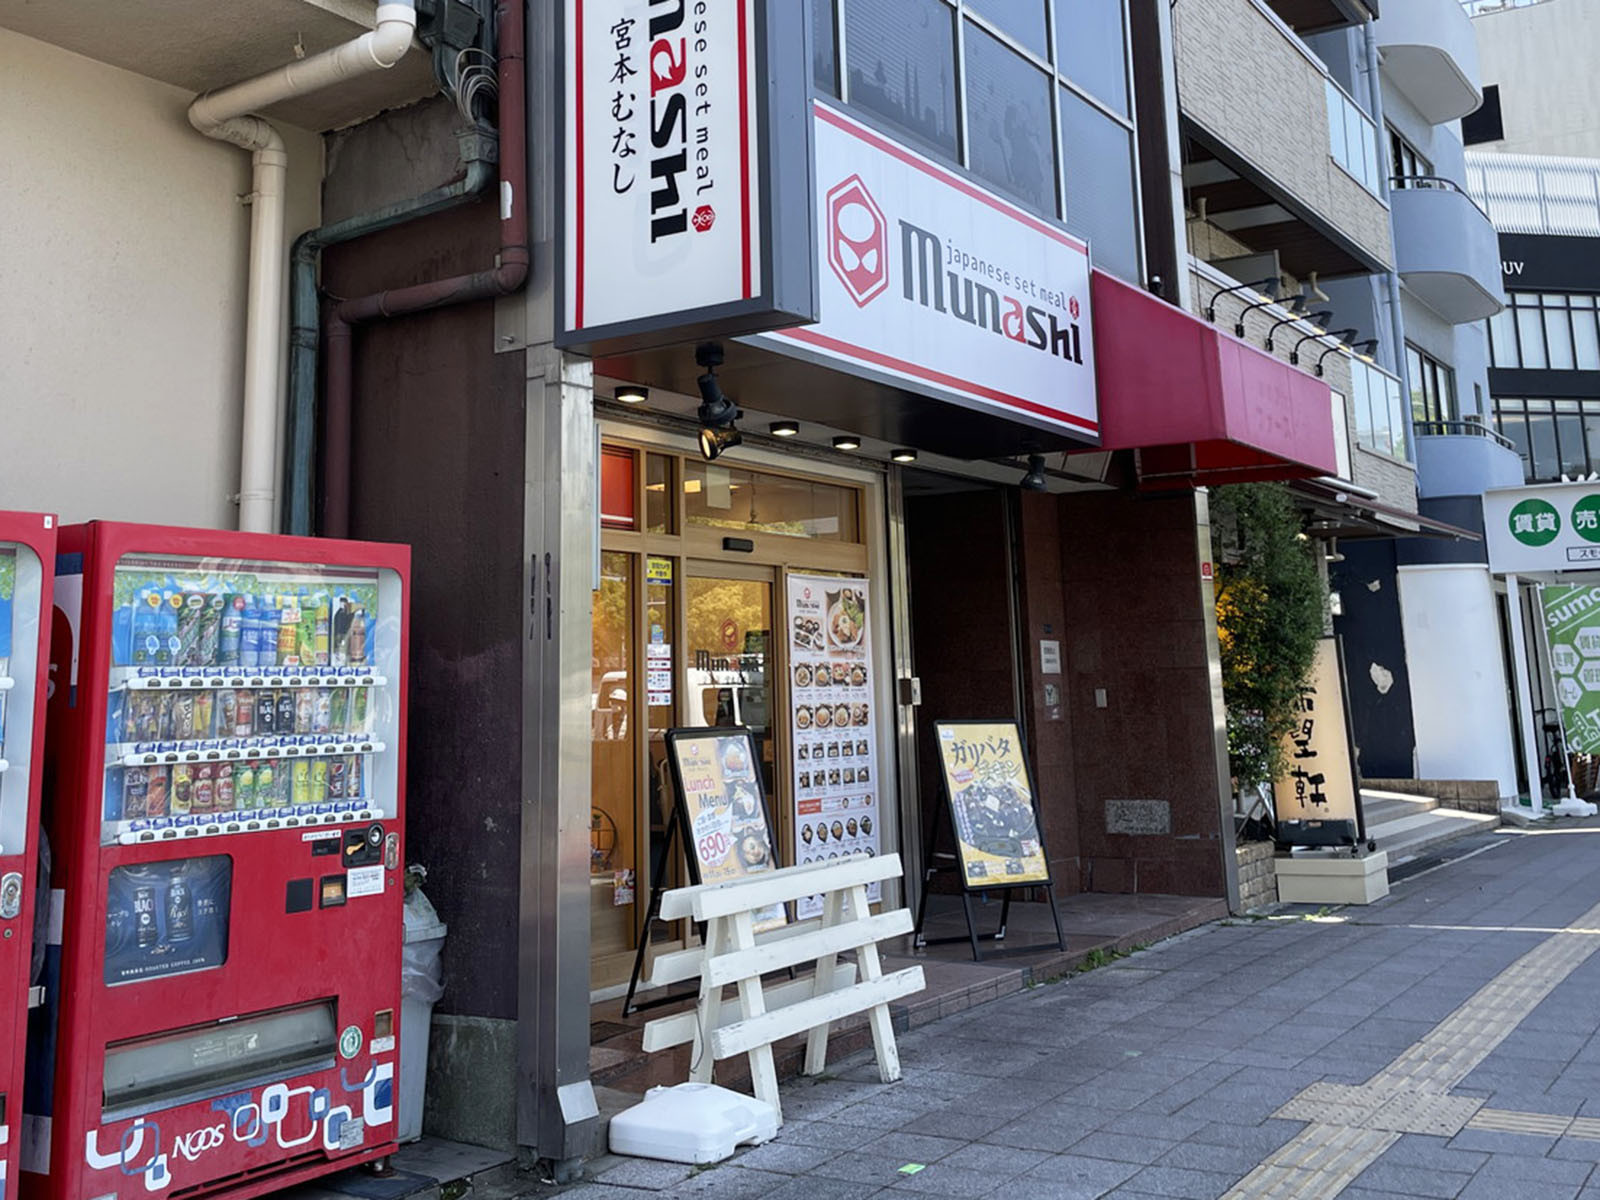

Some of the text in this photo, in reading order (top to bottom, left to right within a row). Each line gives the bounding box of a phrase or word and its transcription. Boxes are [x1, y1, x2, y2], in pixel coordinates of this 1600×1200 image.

[694, 65, 712, 116] set
[609, 18, 637, 195] 宮本むなし
[696, 127, 714, 196] meal
[946, 239, 1067, 312] japanese set meal
[1500, 261, 1524, 275] UV
[1513, 512, 1558, 534] 賃貸
[1575, 510, 1600, 531] 売
[1579, 549, 1600, 558] スモ
[951, 735, 1011, 767] ガリバタ
[684, 775, 715, 792] Lunch
[698, 793, 728, 809] Menu
[698, 831, 726, 861] 690
